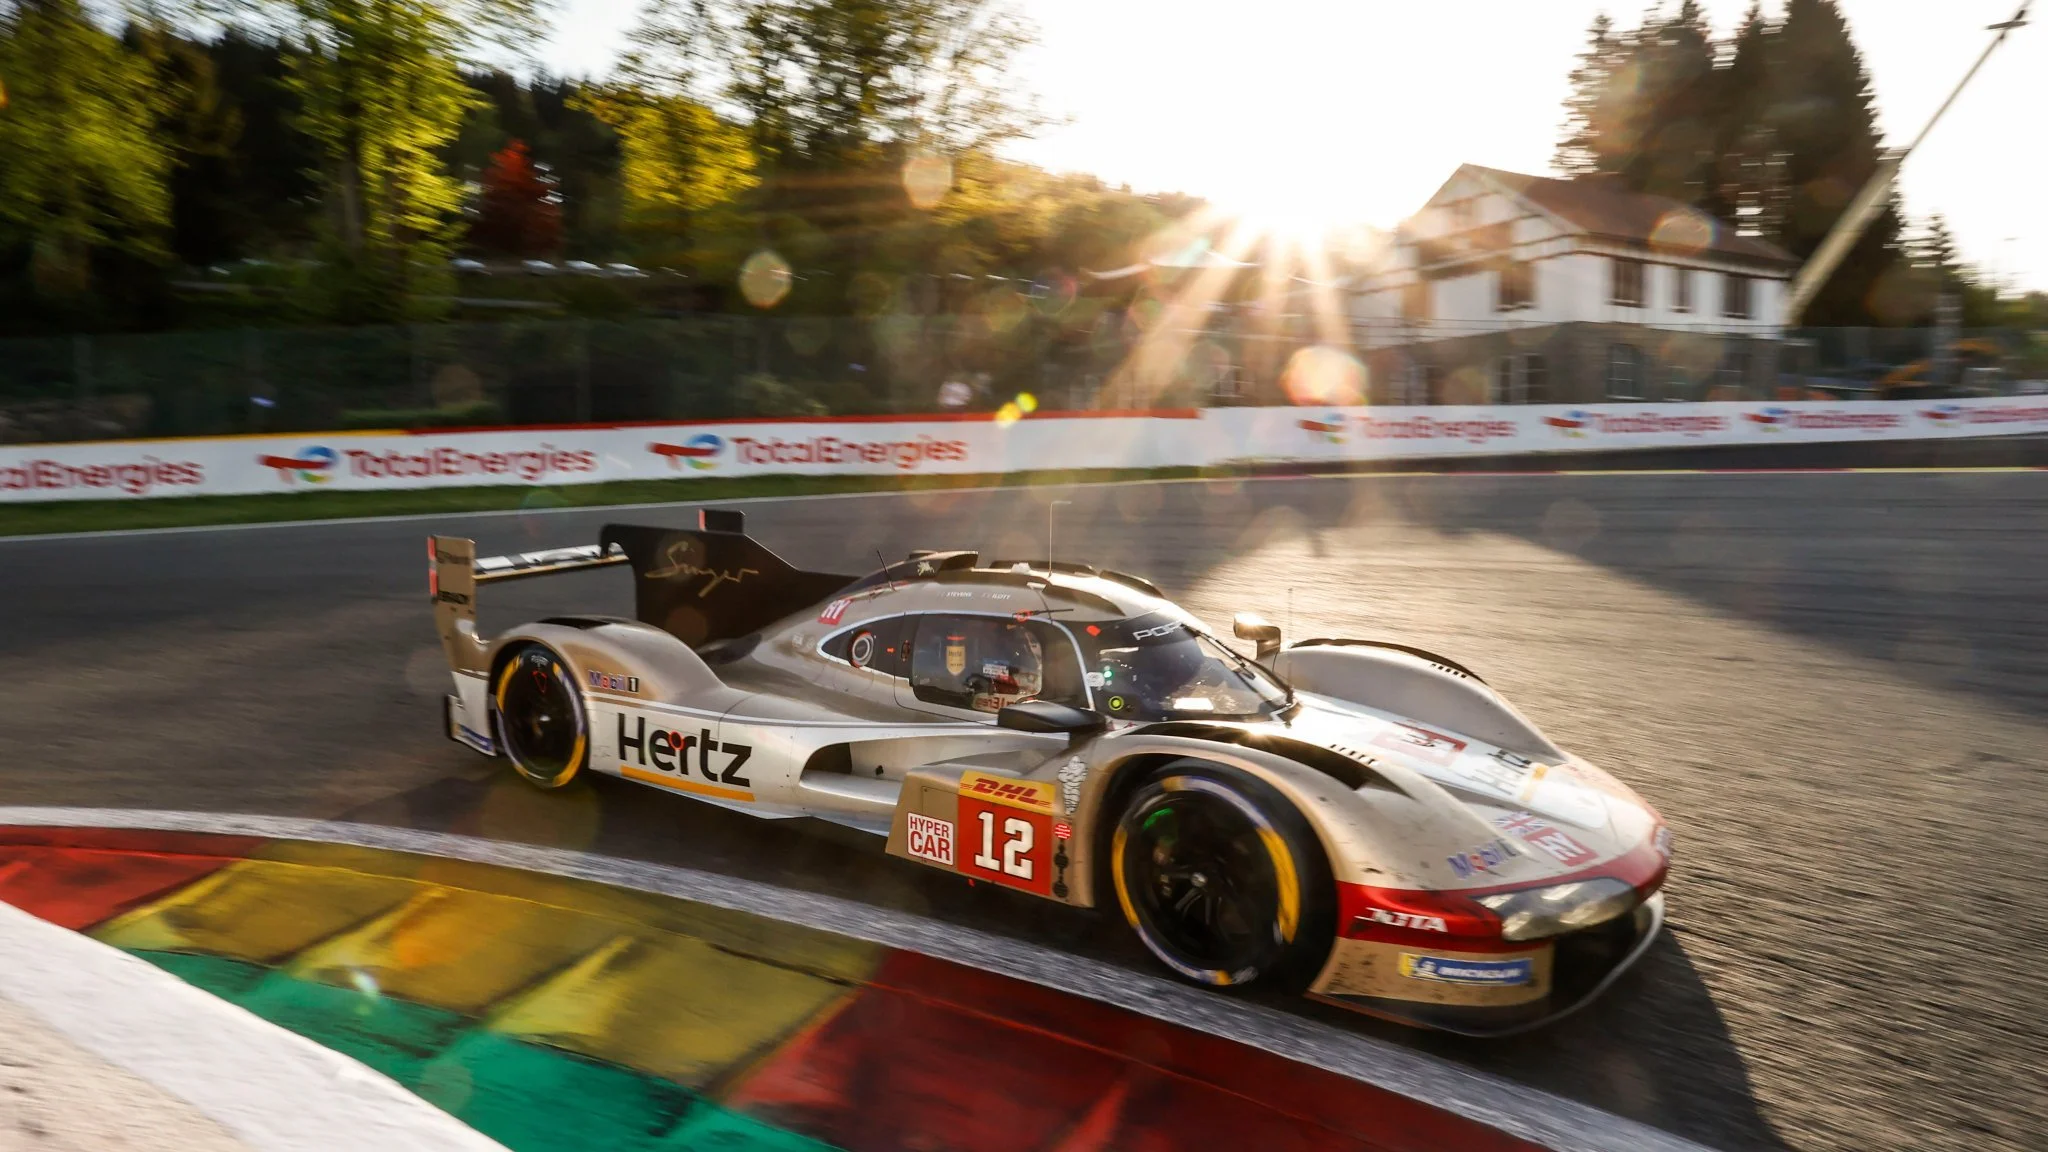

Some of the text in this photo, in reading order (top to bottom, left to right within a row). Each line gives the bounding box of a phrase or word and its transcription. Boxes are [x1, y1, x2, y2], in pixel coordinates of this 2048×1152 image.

[344, 443, 597, 481] TotalEnergies
[731, 434, 967, 470] TotalEnergies
[618, 713, 752, 787] Hertz
[972, 778, 1041, 804] DHL
[910, 816, 949, 838] HYPER
[910, 830, 950, 861] CAR
[974, 811, 1034, 880] 12
